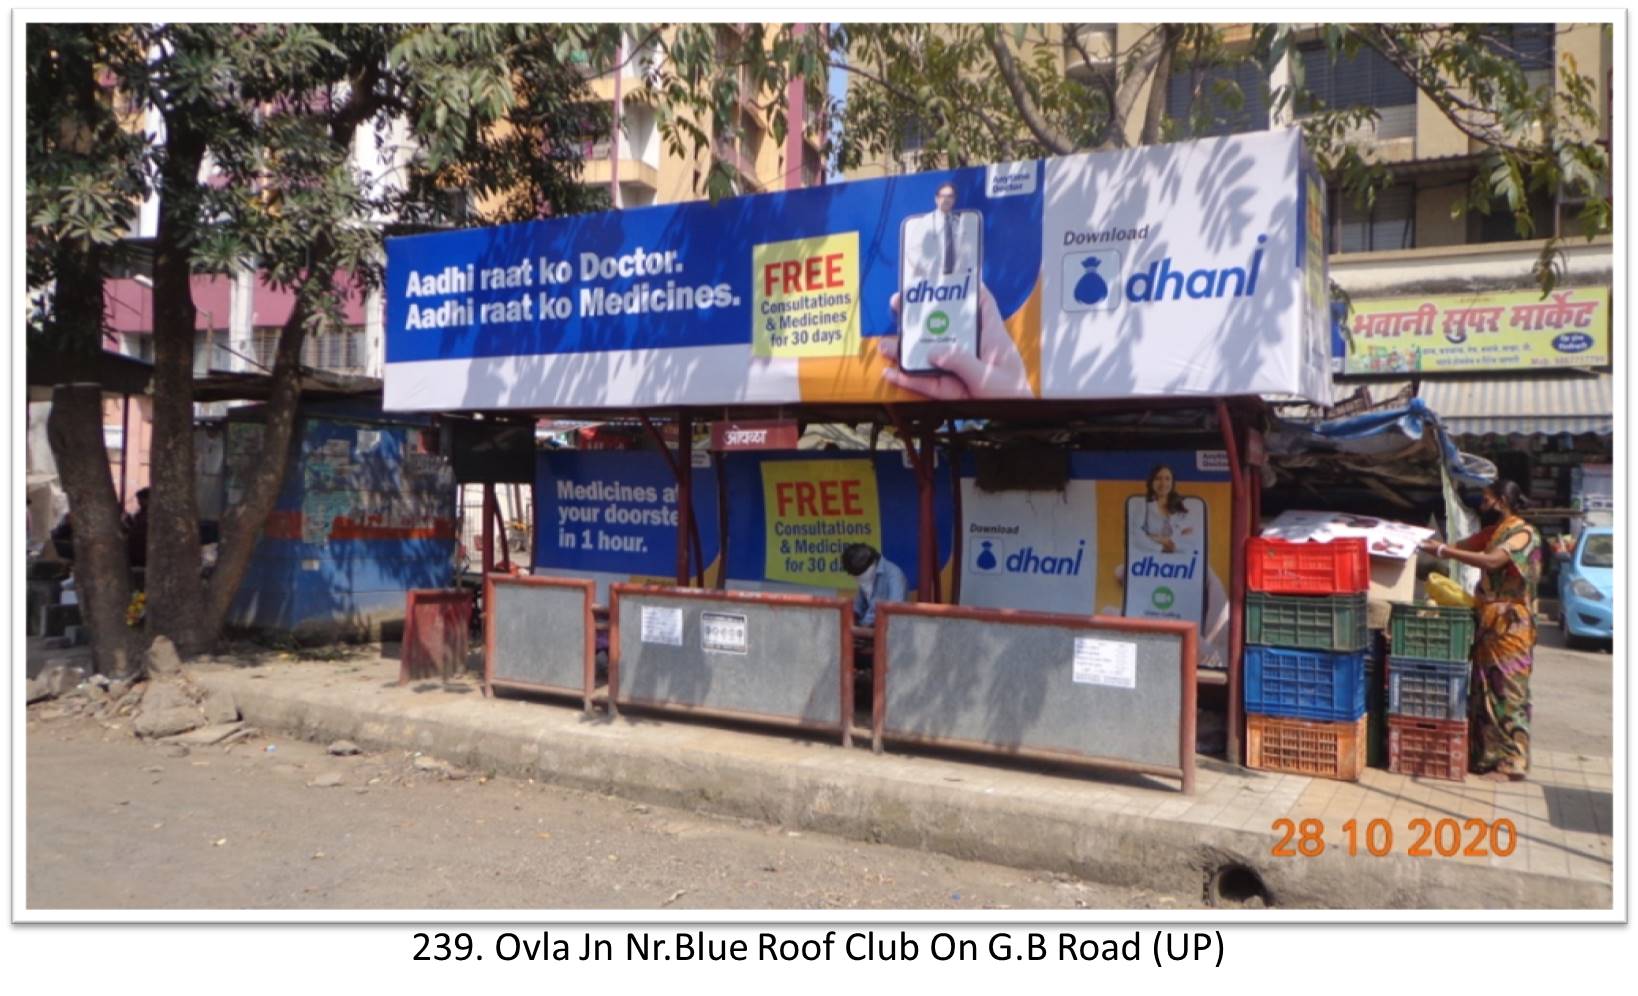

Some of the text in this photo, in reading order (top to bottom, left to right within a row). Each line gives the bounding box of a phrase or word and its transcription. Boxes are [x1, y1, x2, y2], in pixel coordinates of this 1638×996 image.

[1063, 224, 1149, 246] Download
[405, 246, 684, 298] Aadhi raat ko Doctor.
[764, 252, 845, 298] FREE
[1125, 233, 1268, 303] dhani
[907, 268, 972, 303] dhani
[405, 280, 742, 330] Aadhi raat ko Medicines.
[761, 293, 851, 315] Consultations
[1353, 303, 1438, 338] भवानी
[1509, 290, 1600, 331] मार्केट
[765, 311, 847, 331] & Medicines
[770, 328, 842, 347] for 30 days
[557, 480, 658, 503] Medicines
[775, 479, 865, 518] FREE
[558, 503, 679, 527] your doorste
[558, 527, 648, 553] in 1 hour.
[775, 520, 872, 536] Consultations
[969, 523, 1020, 535] Download
[780, 539, 849, 554] & Medici
[1005, 539, 1086, 577] dhani
[785, 557, 804, 572] for
[807, 557, 826, 572] 30
[1131, 550, 1199, 580] dhani
